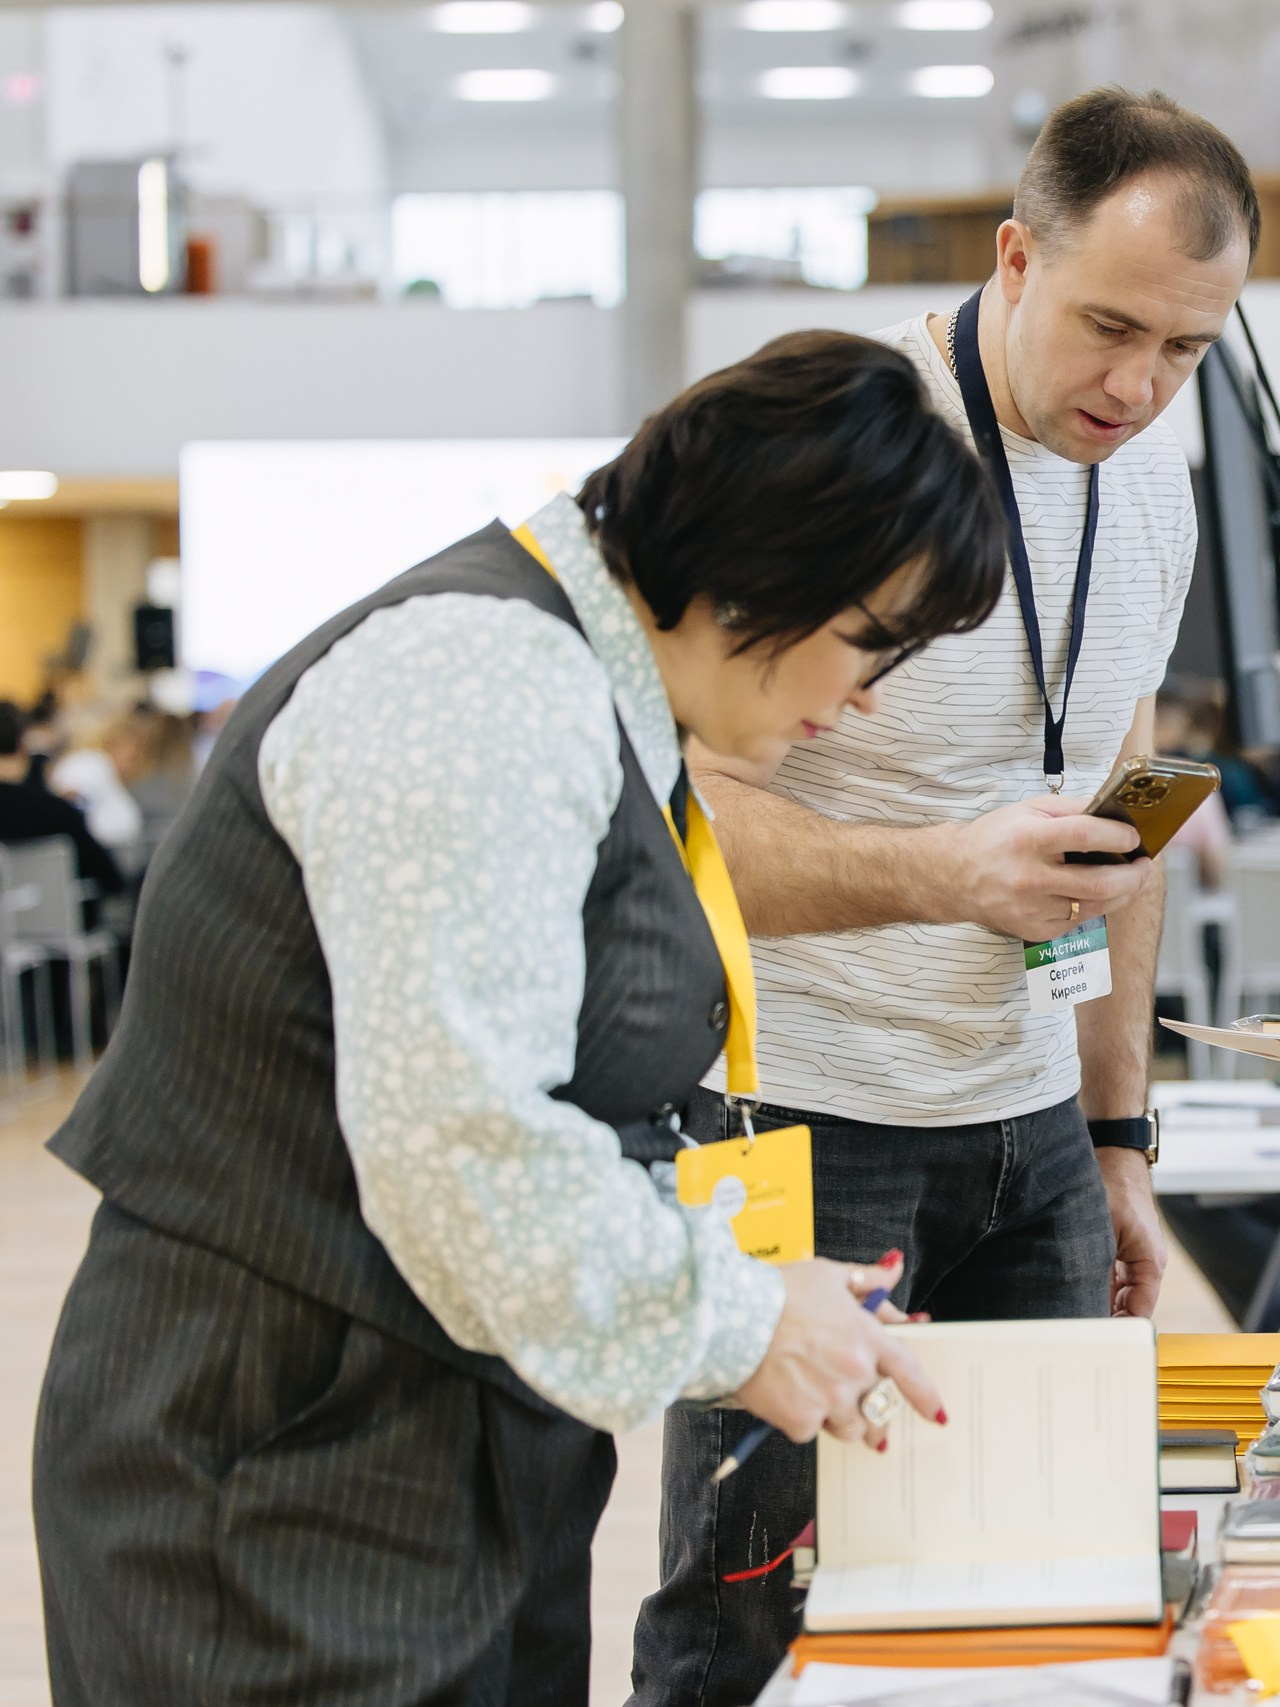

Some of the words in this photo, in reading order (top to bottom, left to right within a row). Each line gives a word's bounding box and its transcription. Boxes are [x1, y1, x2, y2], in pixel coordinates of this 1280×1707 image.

[1038, 938, 1091, 961] УЧАСТНИК
[1049, 961, 1085, 981] Сергей
[1051, 982, 1088, 1000] Киреев
